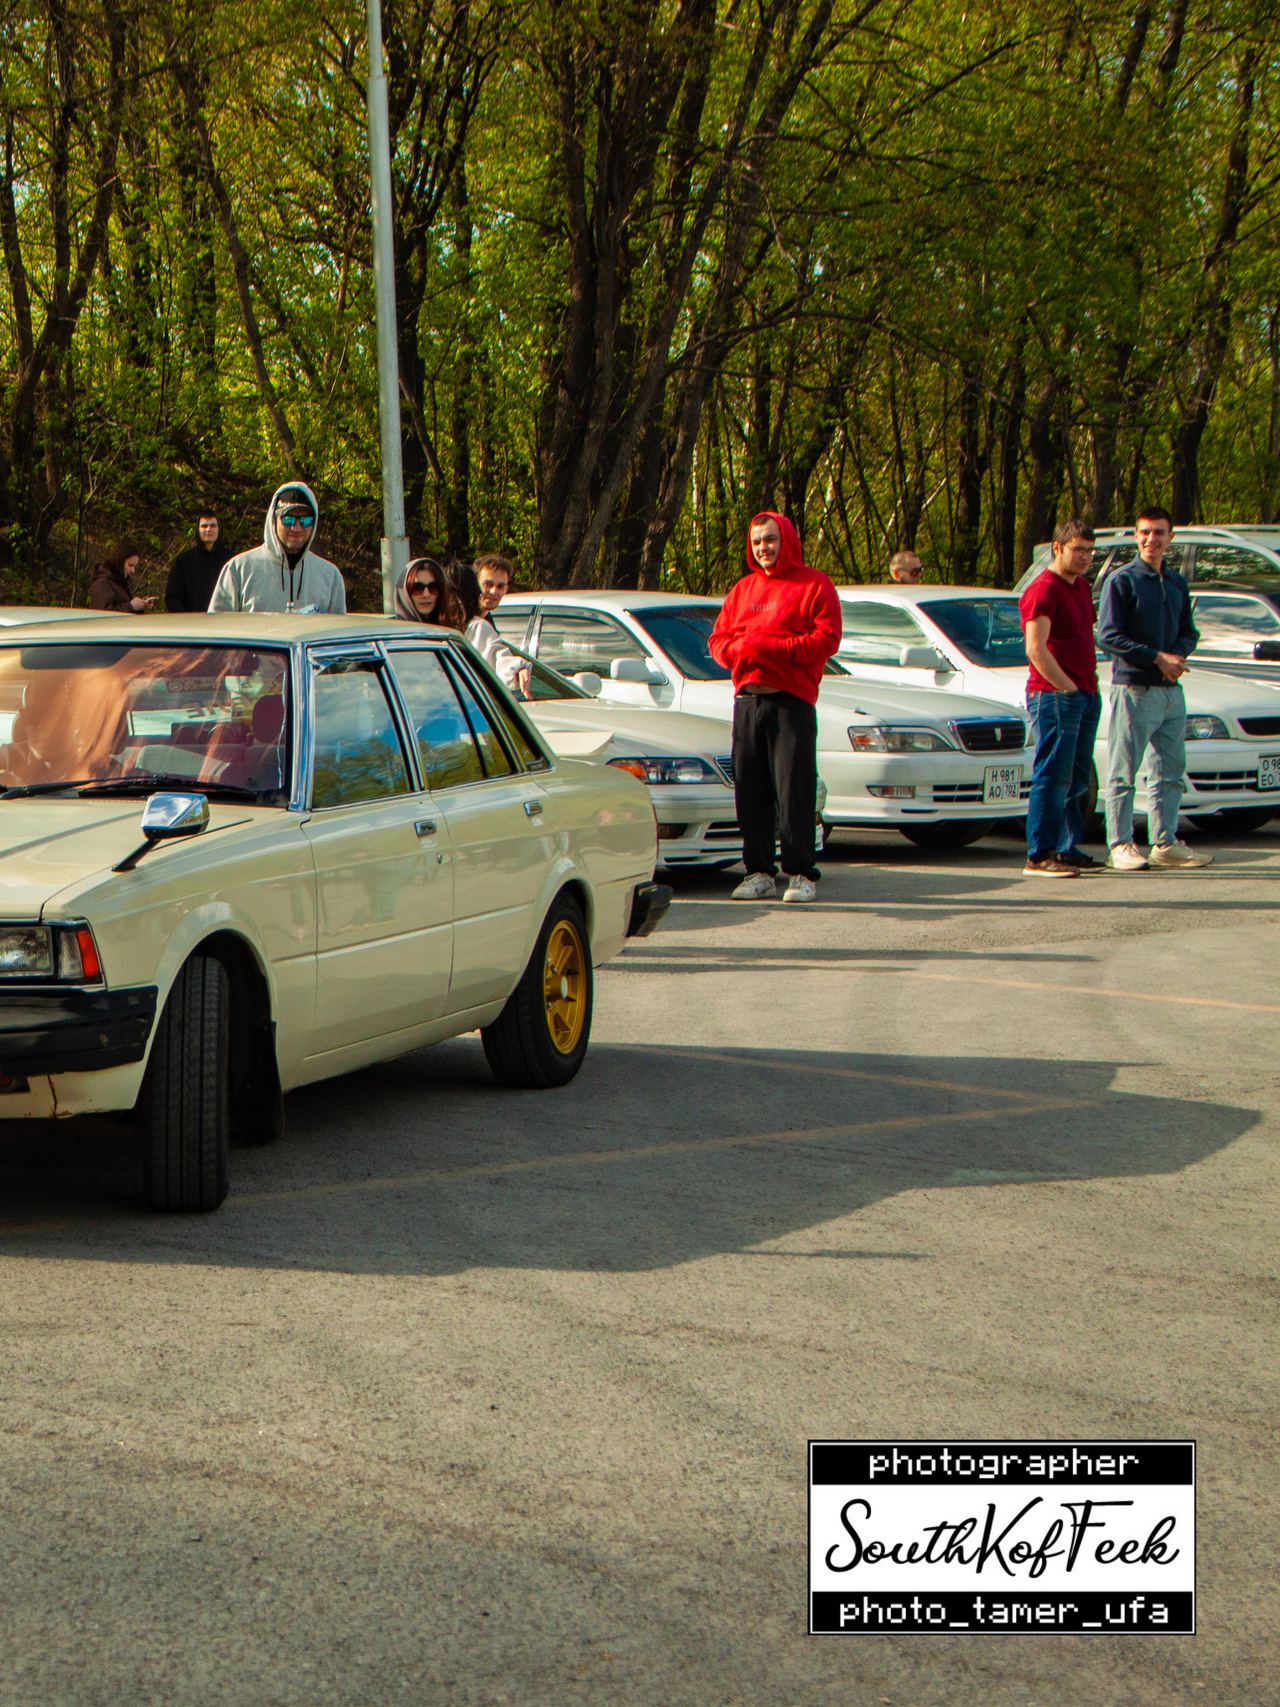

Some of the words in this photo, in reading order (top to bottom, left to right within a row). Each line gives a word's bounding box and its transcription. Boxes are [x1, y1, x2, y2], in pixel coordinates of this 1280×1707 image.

[991, 770, 997, 782] Н
[1000, 769, 1014, 781] 981
[989, 785, 1001, 798] АО
